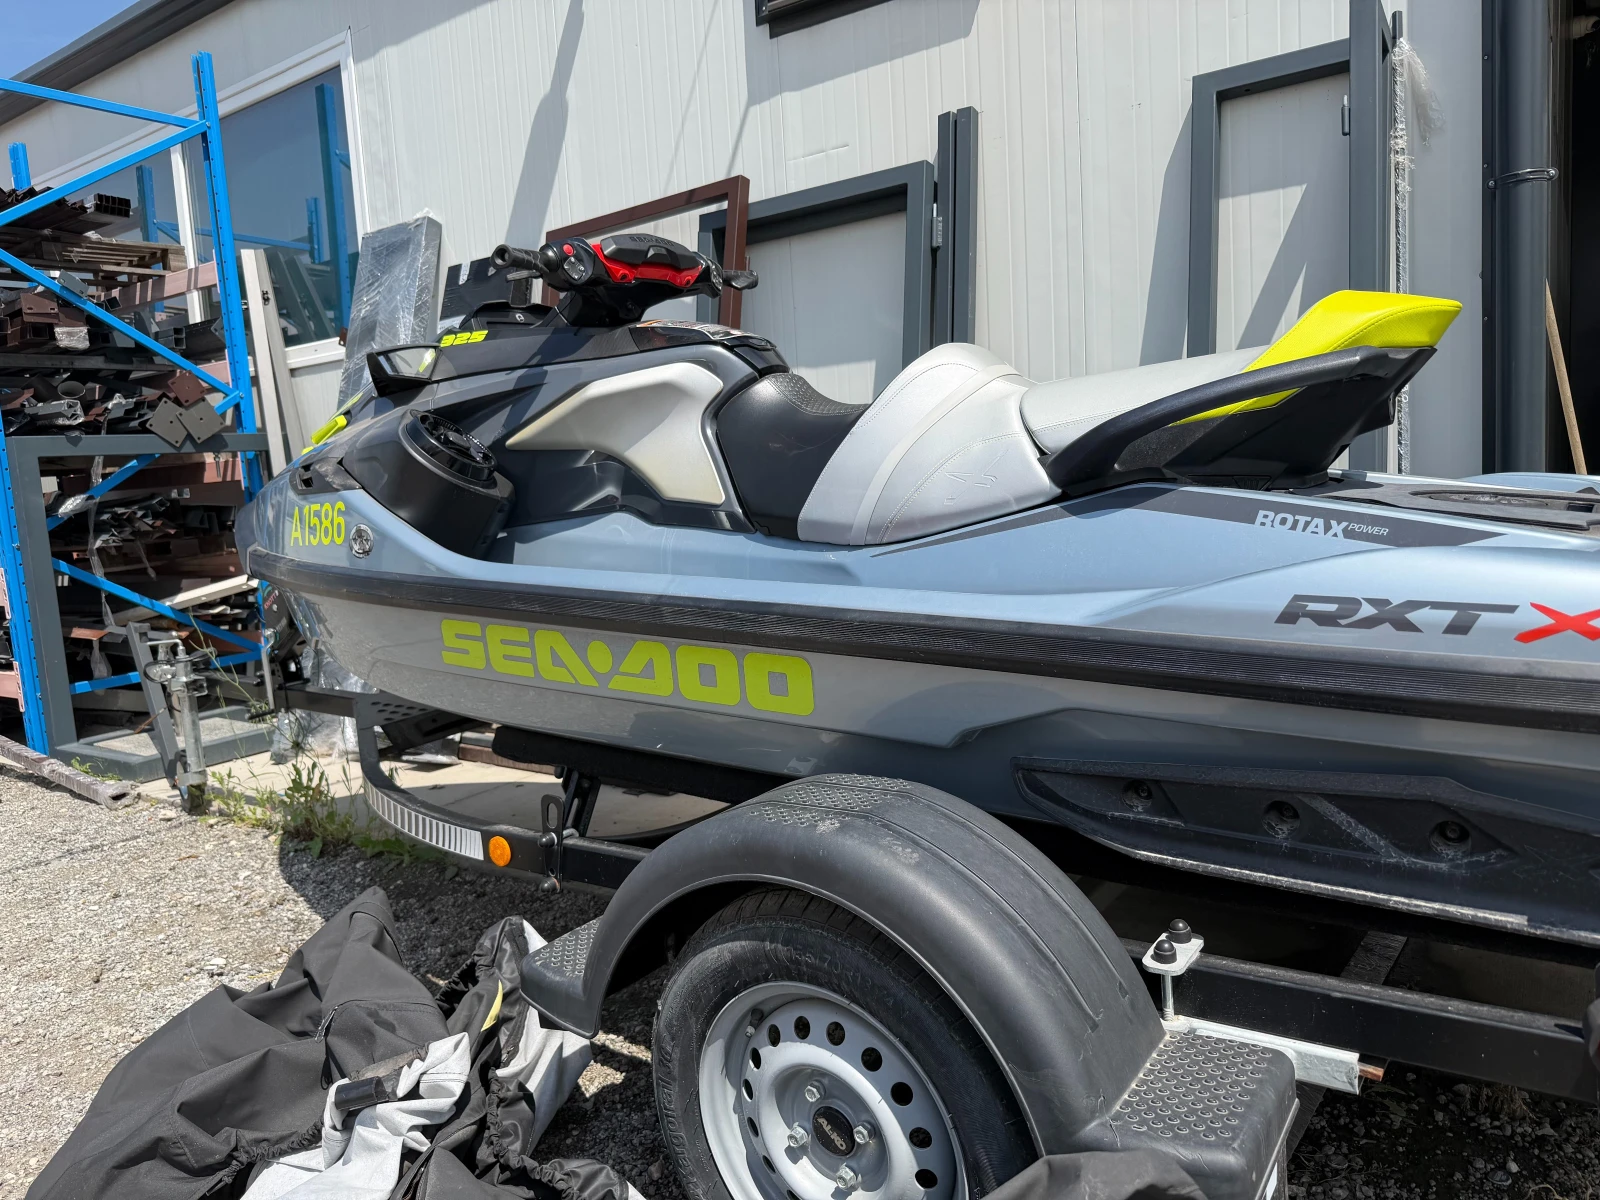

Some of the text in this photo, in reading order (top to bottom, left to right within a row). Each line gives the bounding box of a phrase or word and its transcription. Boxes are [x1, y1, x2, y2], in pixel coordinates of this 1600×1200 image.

[440, 330, 488, 347] 325
[290, 501, 346, 547] A1586
[1254, 509, 1389, 539] ROTAX POWER
[1273, 593, 1520, 636] RXT
[817, 1117, 847, 1150] AL-KO
